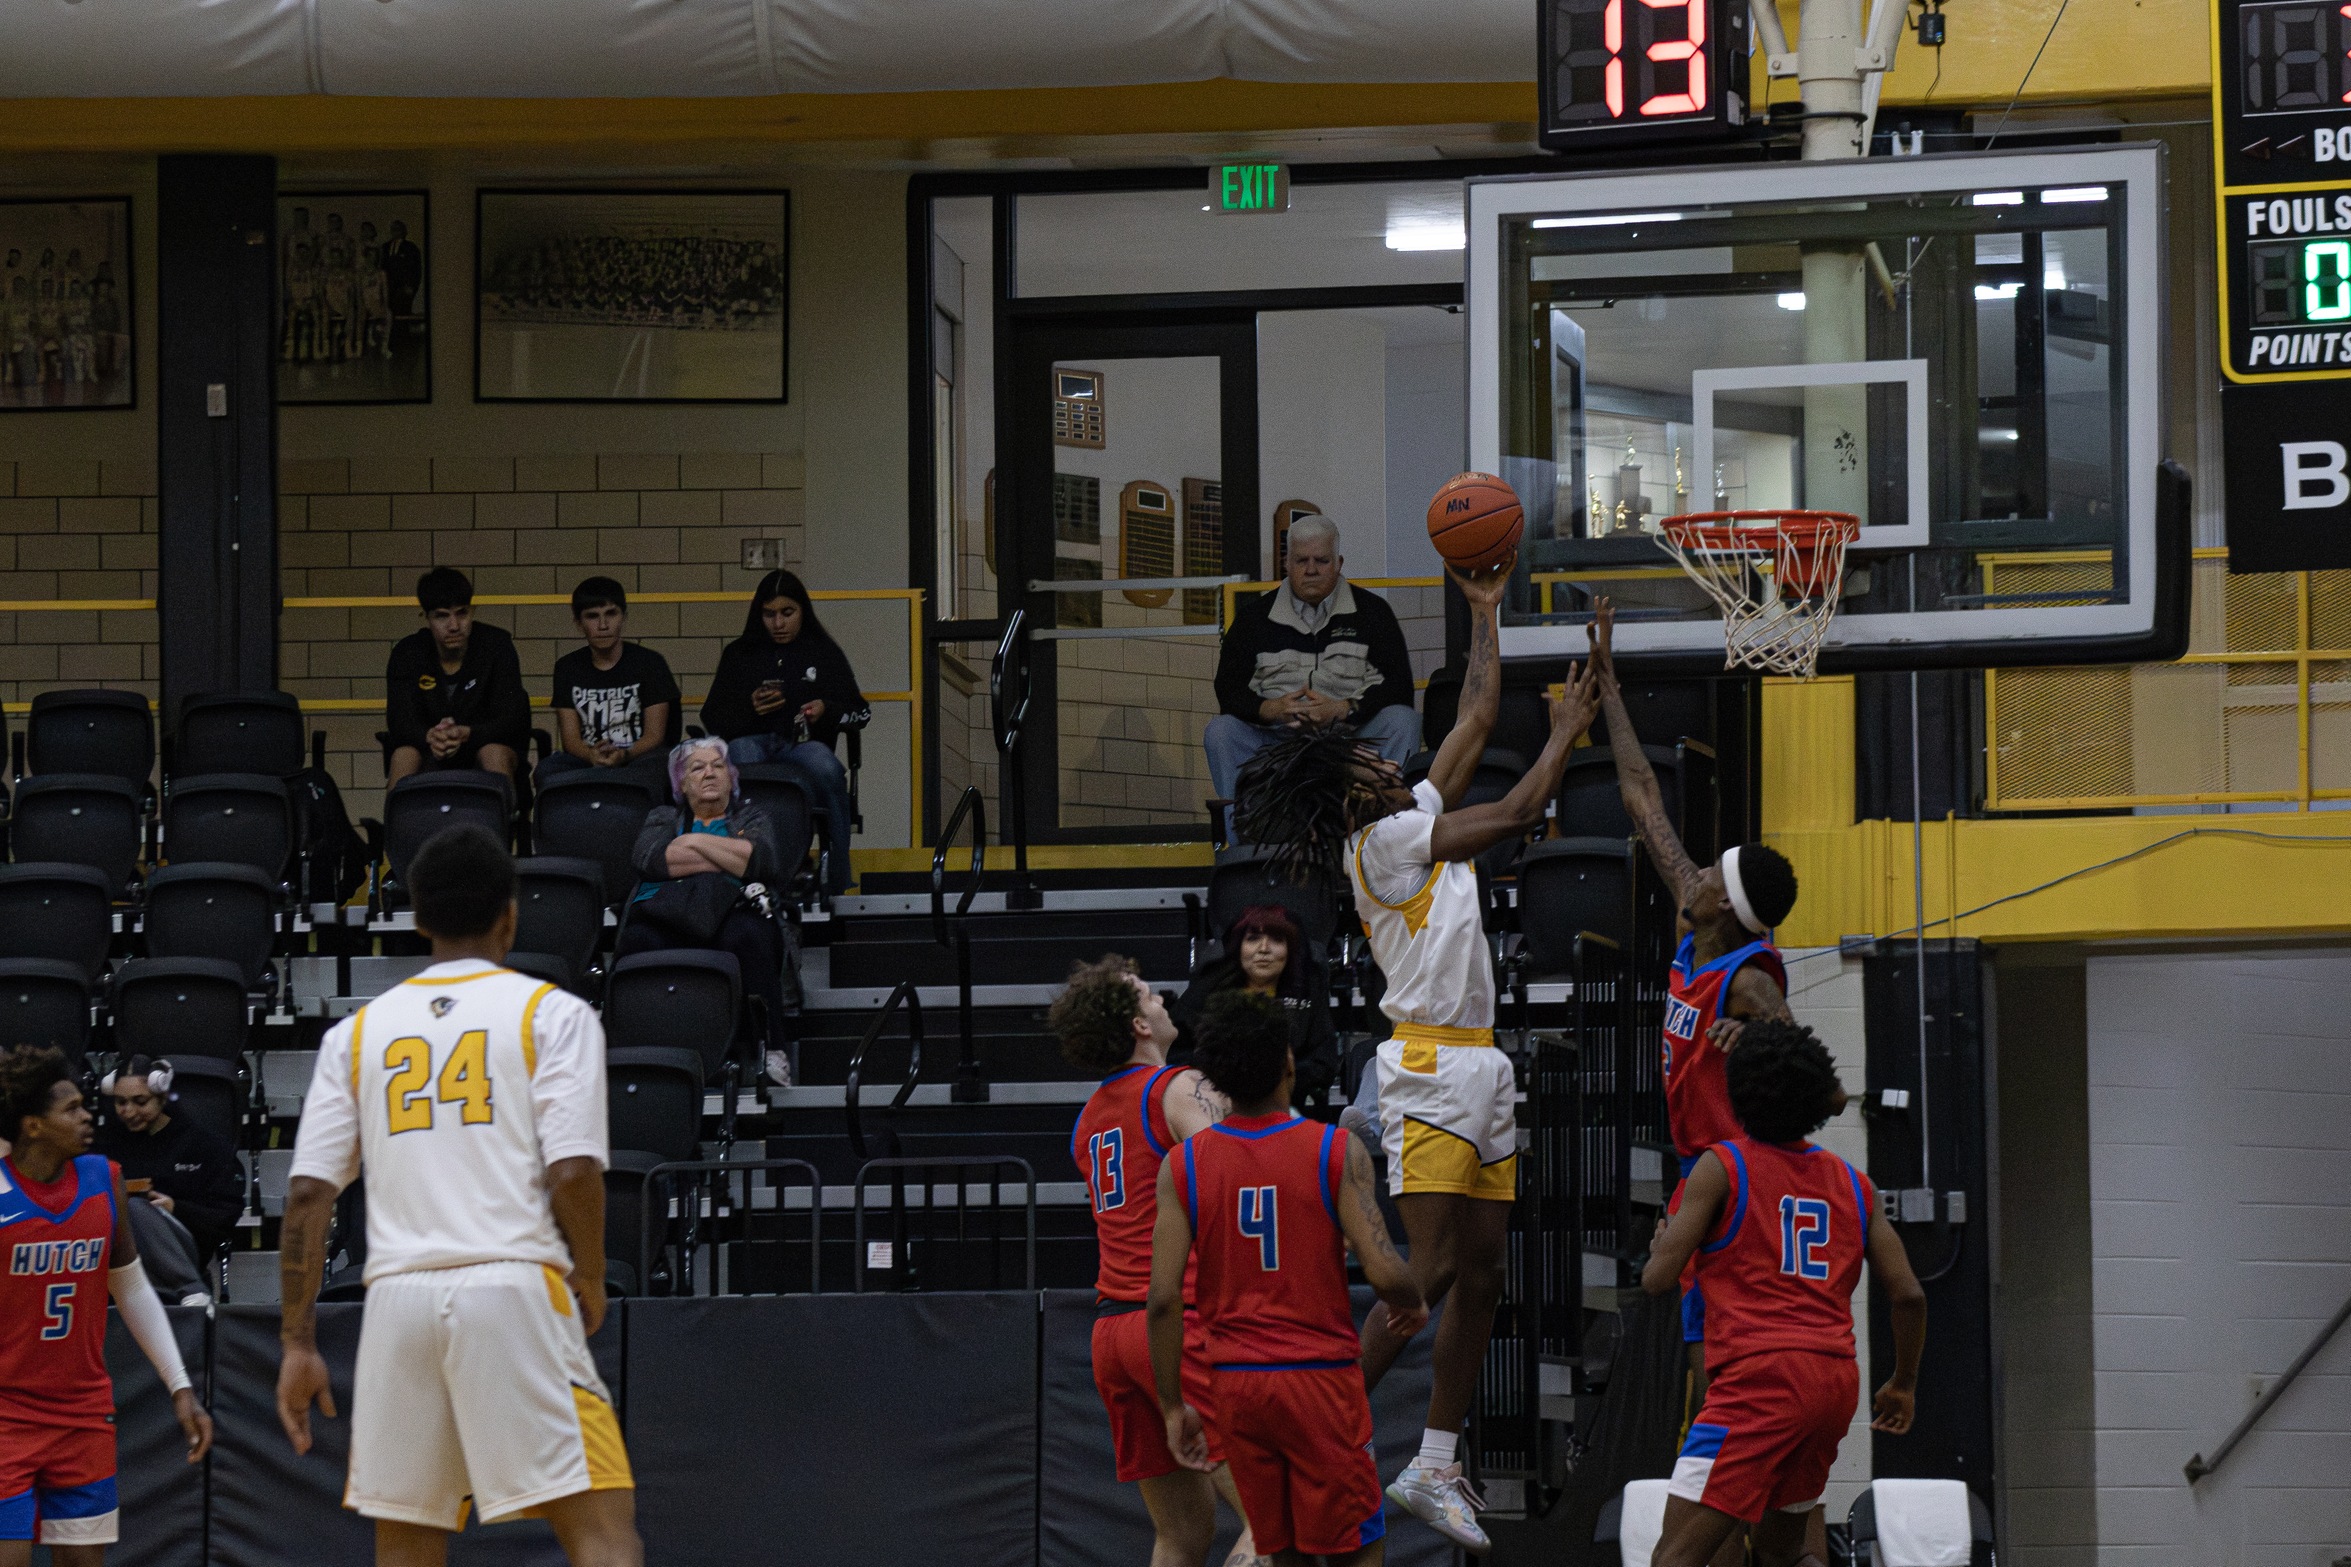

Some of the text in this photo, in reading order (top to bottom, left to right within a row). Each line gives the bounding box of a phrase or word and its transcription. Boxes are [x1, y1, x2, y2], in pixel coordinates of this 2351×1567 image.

[1604, 0, 1707, 119] 13
[1222, 165, 1279, 210] EXIT
[2247, 195, 2351, 236] FOULS
[2304, 242, 2350, 321] 0
[2279, 440, 2350, 511] B
[572, 683, 641, 702] DISTRICT
[1665, 993, 1701, 1041] TCH
[385, 1029, 492, 1136] 24
[1089, 1127, 1125, 1213] 13
[9, 1237, 106, 1275] HUTCH
[1238, 1185, 1279, 1271] 4
[1779, 1194, 1831, 1280] 12
[40, 1282, 77, 1340] 5
